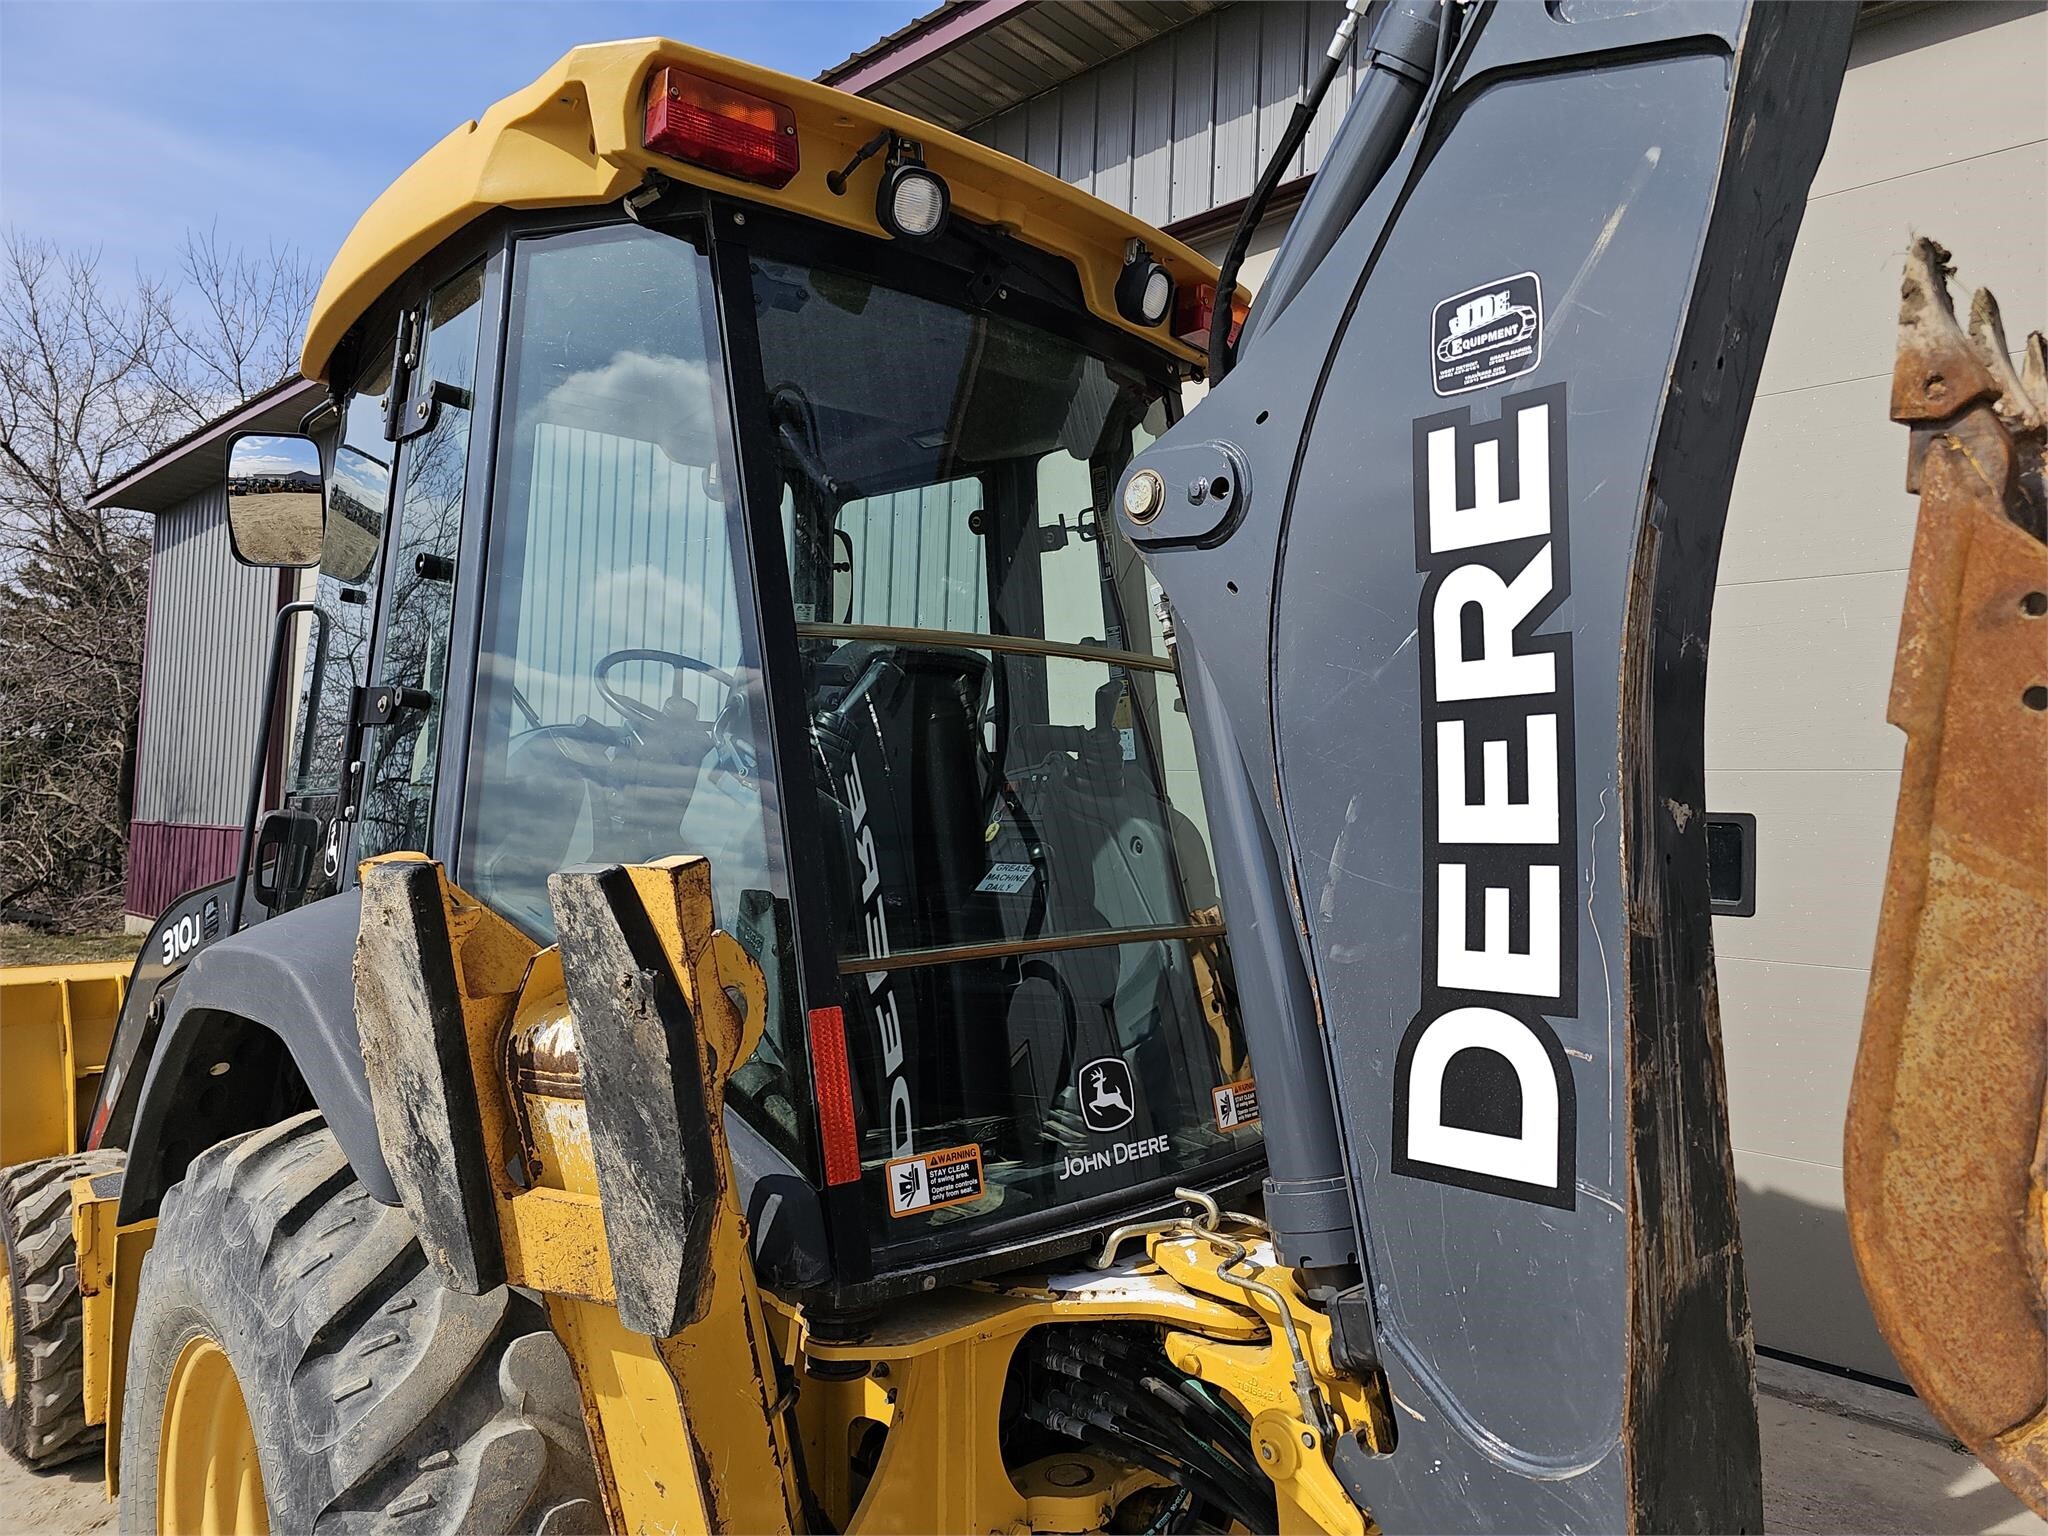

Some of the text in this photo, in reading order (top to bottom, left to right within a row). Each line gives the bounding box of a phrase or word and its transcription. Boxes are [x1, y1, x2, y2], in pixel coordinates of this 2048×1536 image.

[1452, 325, 1519, 355] EQUIPMENT
[1408, 403, 1559, 1189] DEERE
[996, 864, 1033, 872] GREASE
[987, 873, 1029, 882] MACHINE
[985, 883, 1014, 891] DAILY
[162, 914, 200, 966] 310J
[938, 1148, 976, 1163] WARNING
[1060, 1134, 1170, 1181] JOHN DEERE
[930, 1163, 970, 1178] STAY CLEAR
[932, 1179, 978, 1194] Operate controls
[938, 1175, 955, 1183] swing
[932, 1186, 974, 1201] only from seat.
